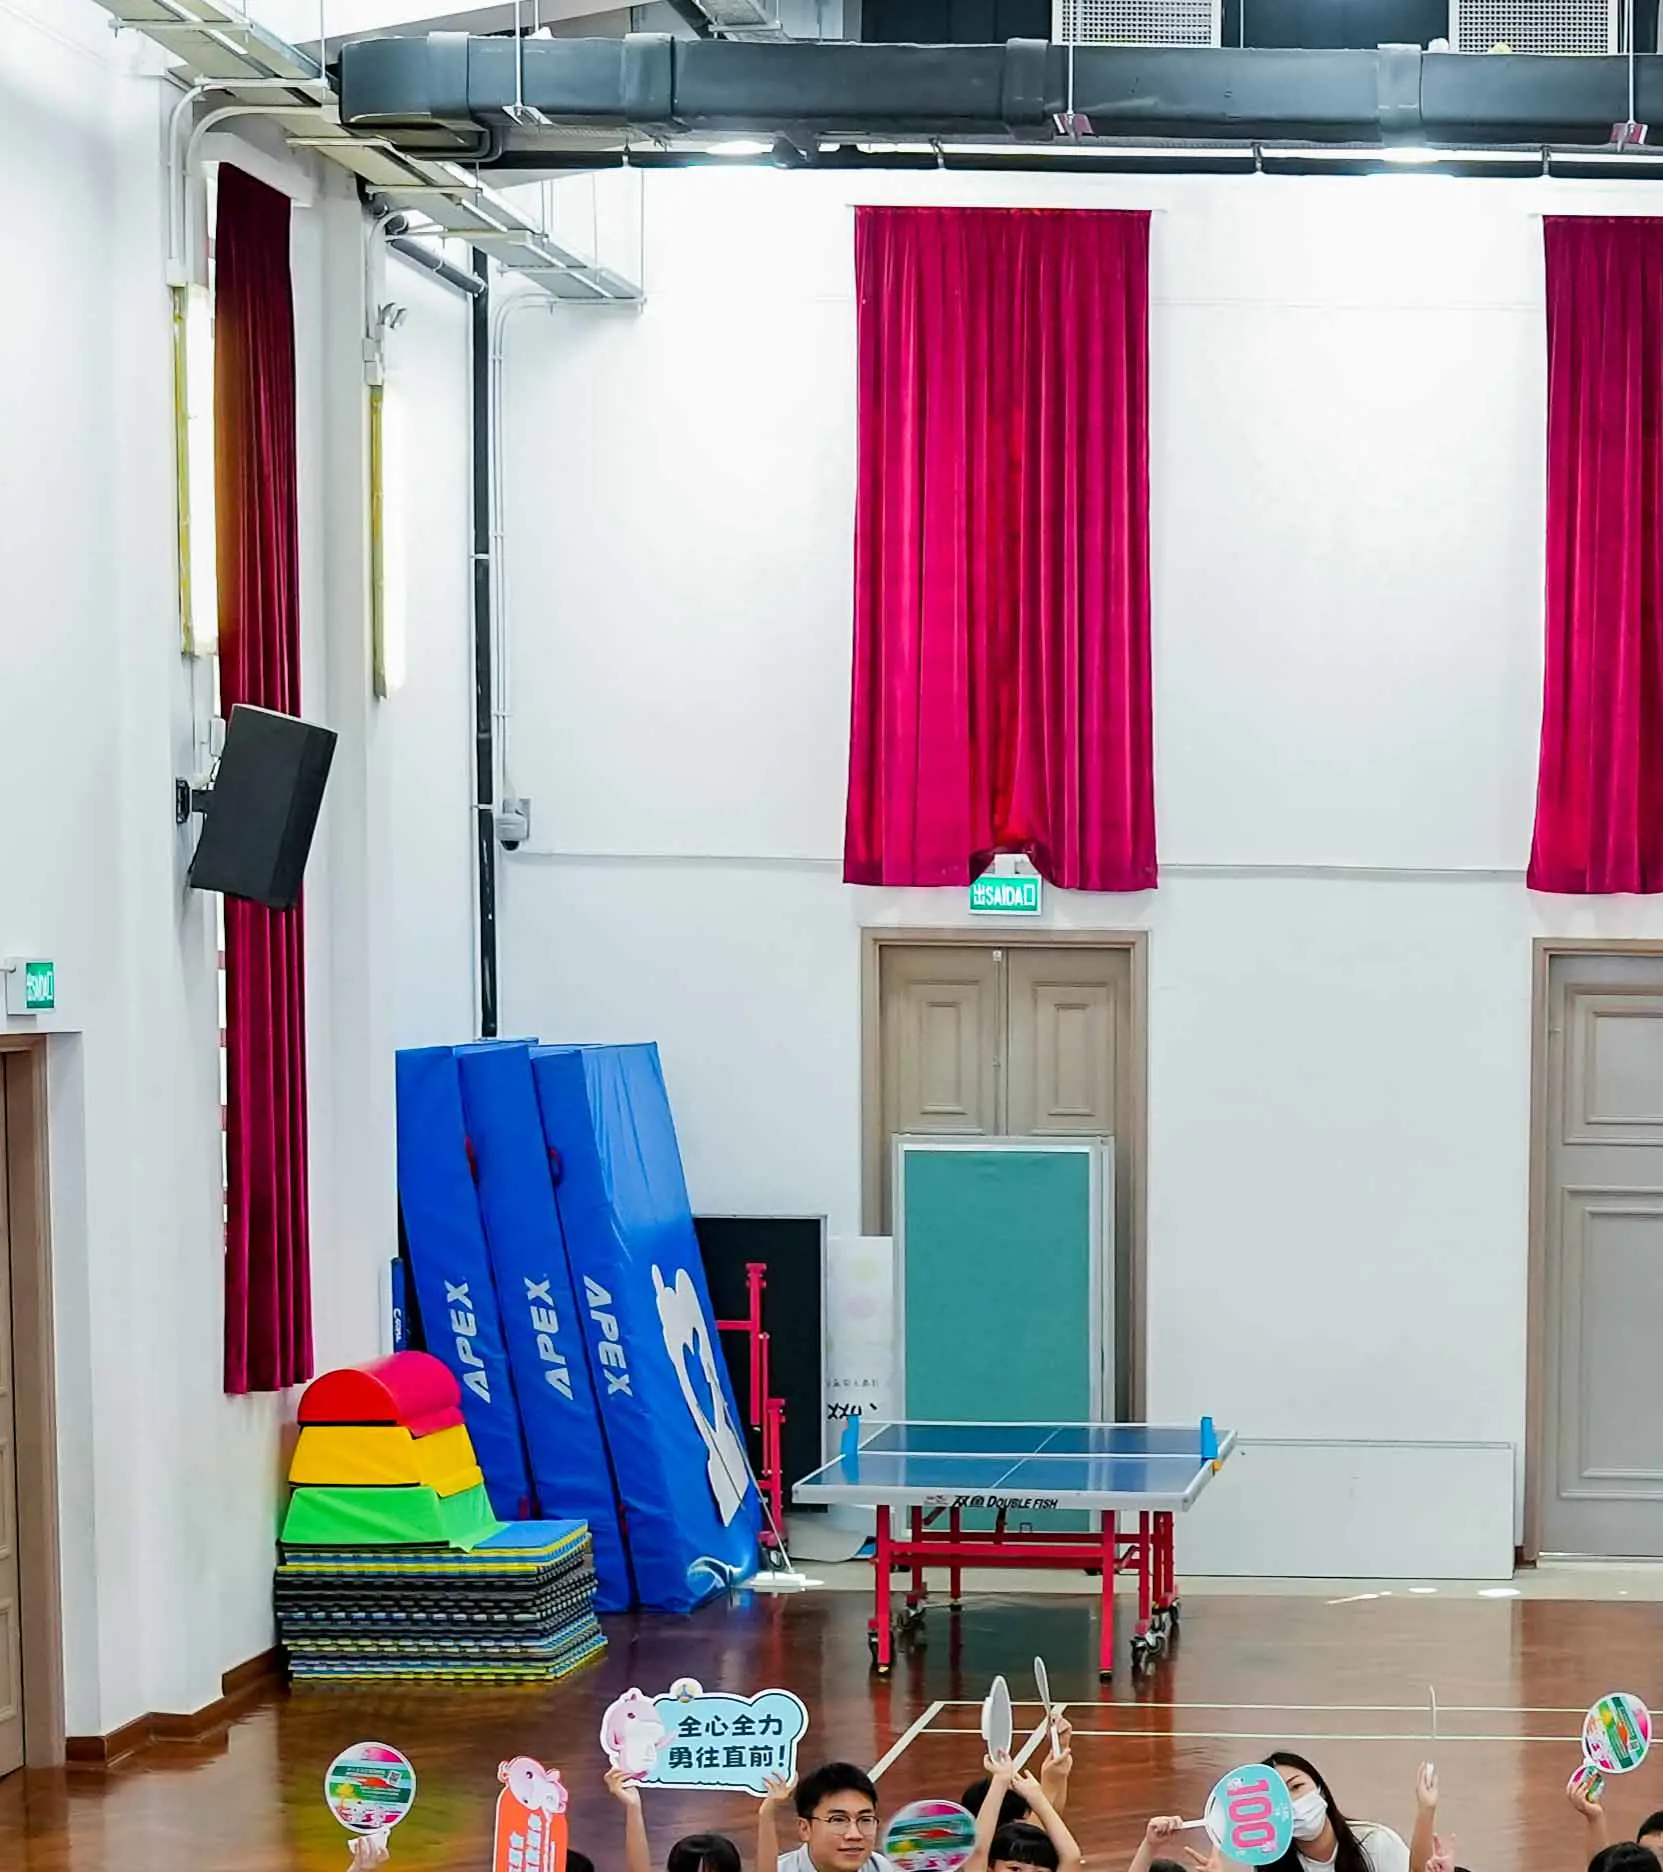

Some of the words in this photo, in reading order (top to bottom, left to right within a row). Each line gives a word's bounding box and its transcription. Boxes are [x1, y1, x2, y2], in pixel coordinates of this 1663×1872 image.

[444, 1279, 491, 1404] APEX
[523, 1276, 574, 1402] APEX
[582, 1274, 634, 1398] APEX
[1032, 1498, 1058, 1510] FISH
[668, 1744, 786, 1769] 勇往直前!
[677, 1713, 783, 1738] 全心全力
[1226, 1778, 1276, 1849] 100
